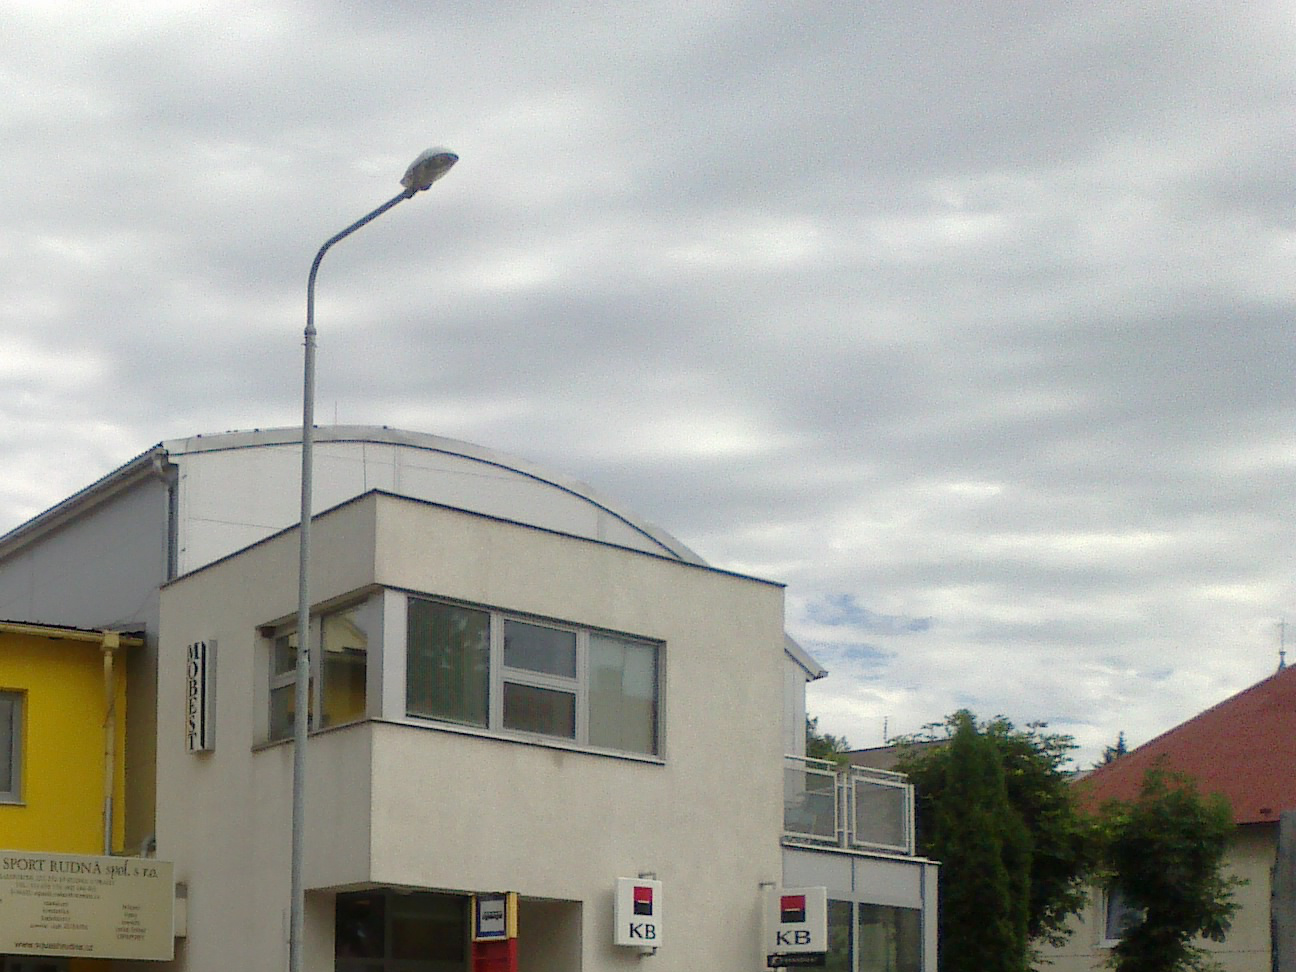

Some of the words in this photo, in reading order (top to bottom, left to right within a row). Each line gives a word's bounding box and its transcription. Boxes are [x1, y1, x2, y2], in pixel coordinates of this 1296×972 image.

[2, 858, 45, 872] SPORT
[50, 860, 102, 875] RUDNÁ
[105, 859, 131, 880] spol.
[134, 867, 140, 876] s
[628, 922, 657, 940] KB
[775, 929, 812, 946] KB
